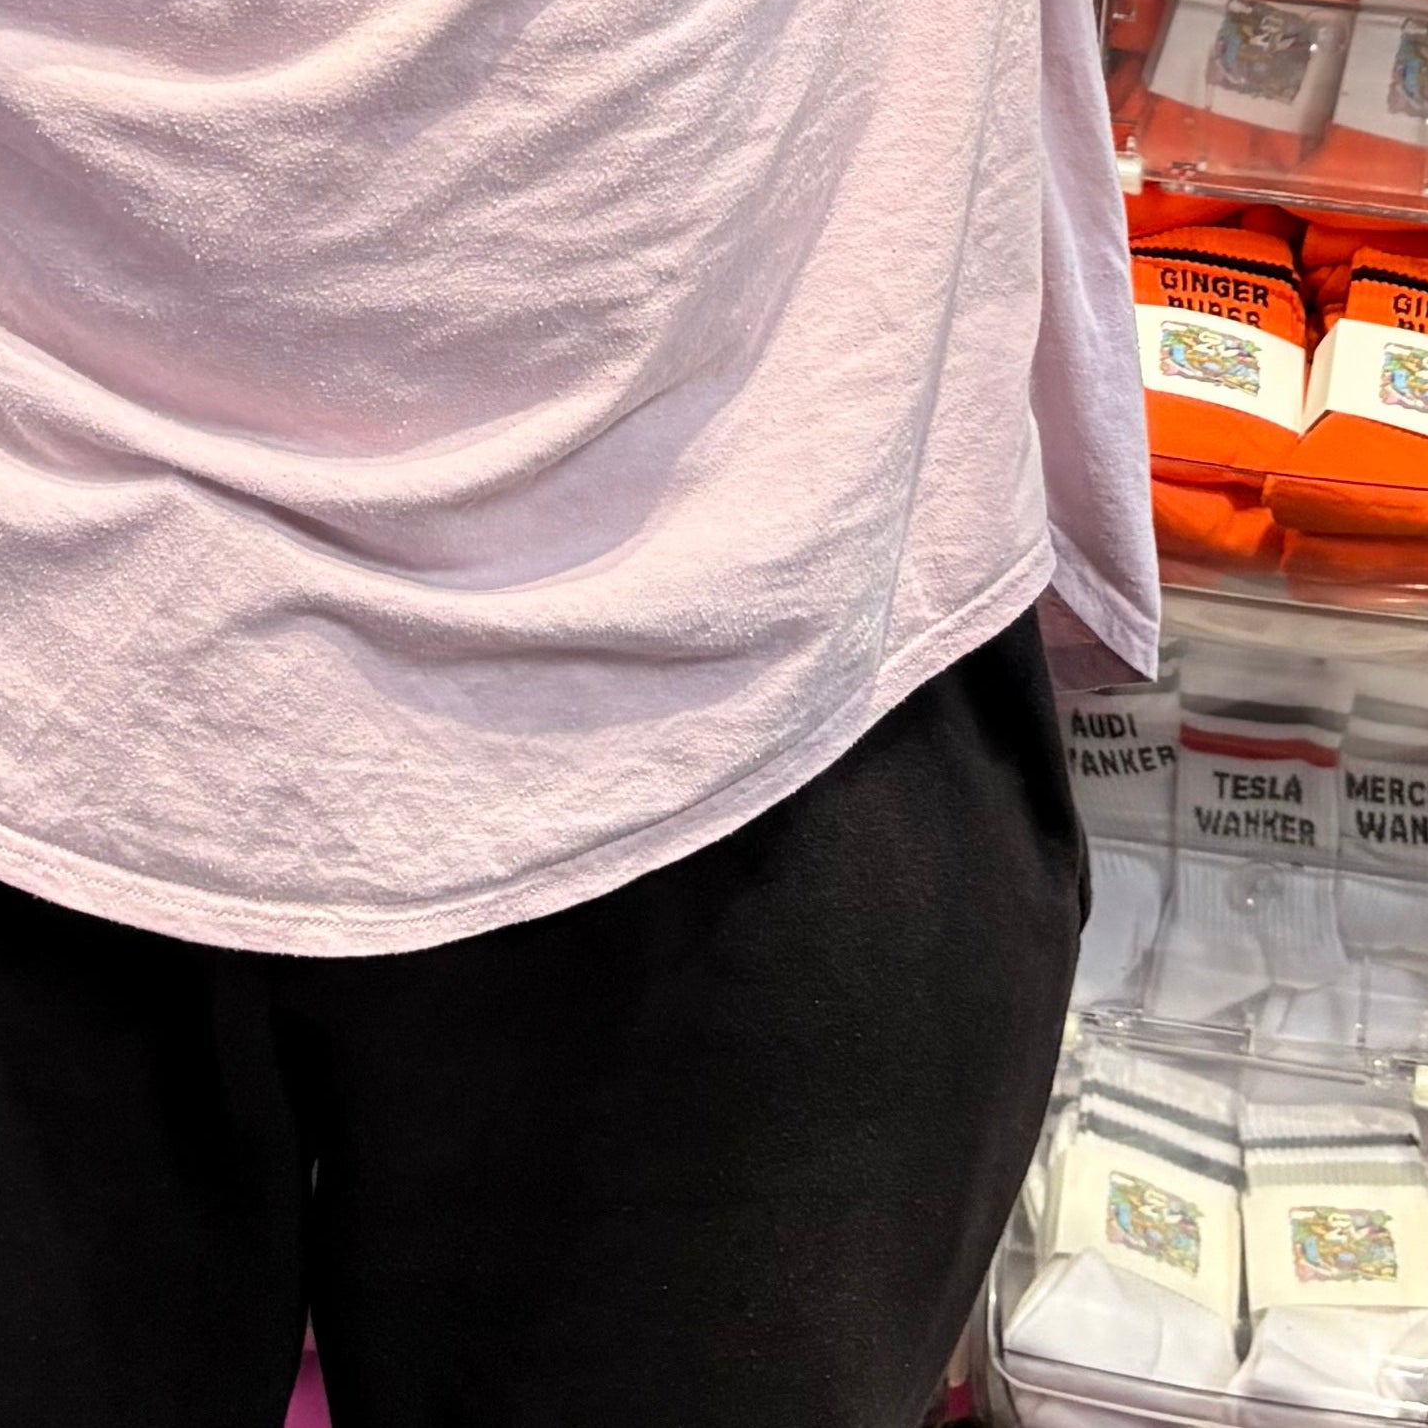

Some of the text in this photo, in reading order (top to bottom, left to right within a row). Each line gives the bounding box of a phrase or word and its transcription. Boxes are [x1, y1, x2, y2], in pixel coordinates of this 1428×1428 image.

[1160, 266, 1270, 309] GINGER
[1071, 712, 1139, 740] AUDI
[1068, 744, 1178, 779] ANKER
[1213, 769, 1305, 805] TESLA
[1193, 805, 1318, 848] WANKER
